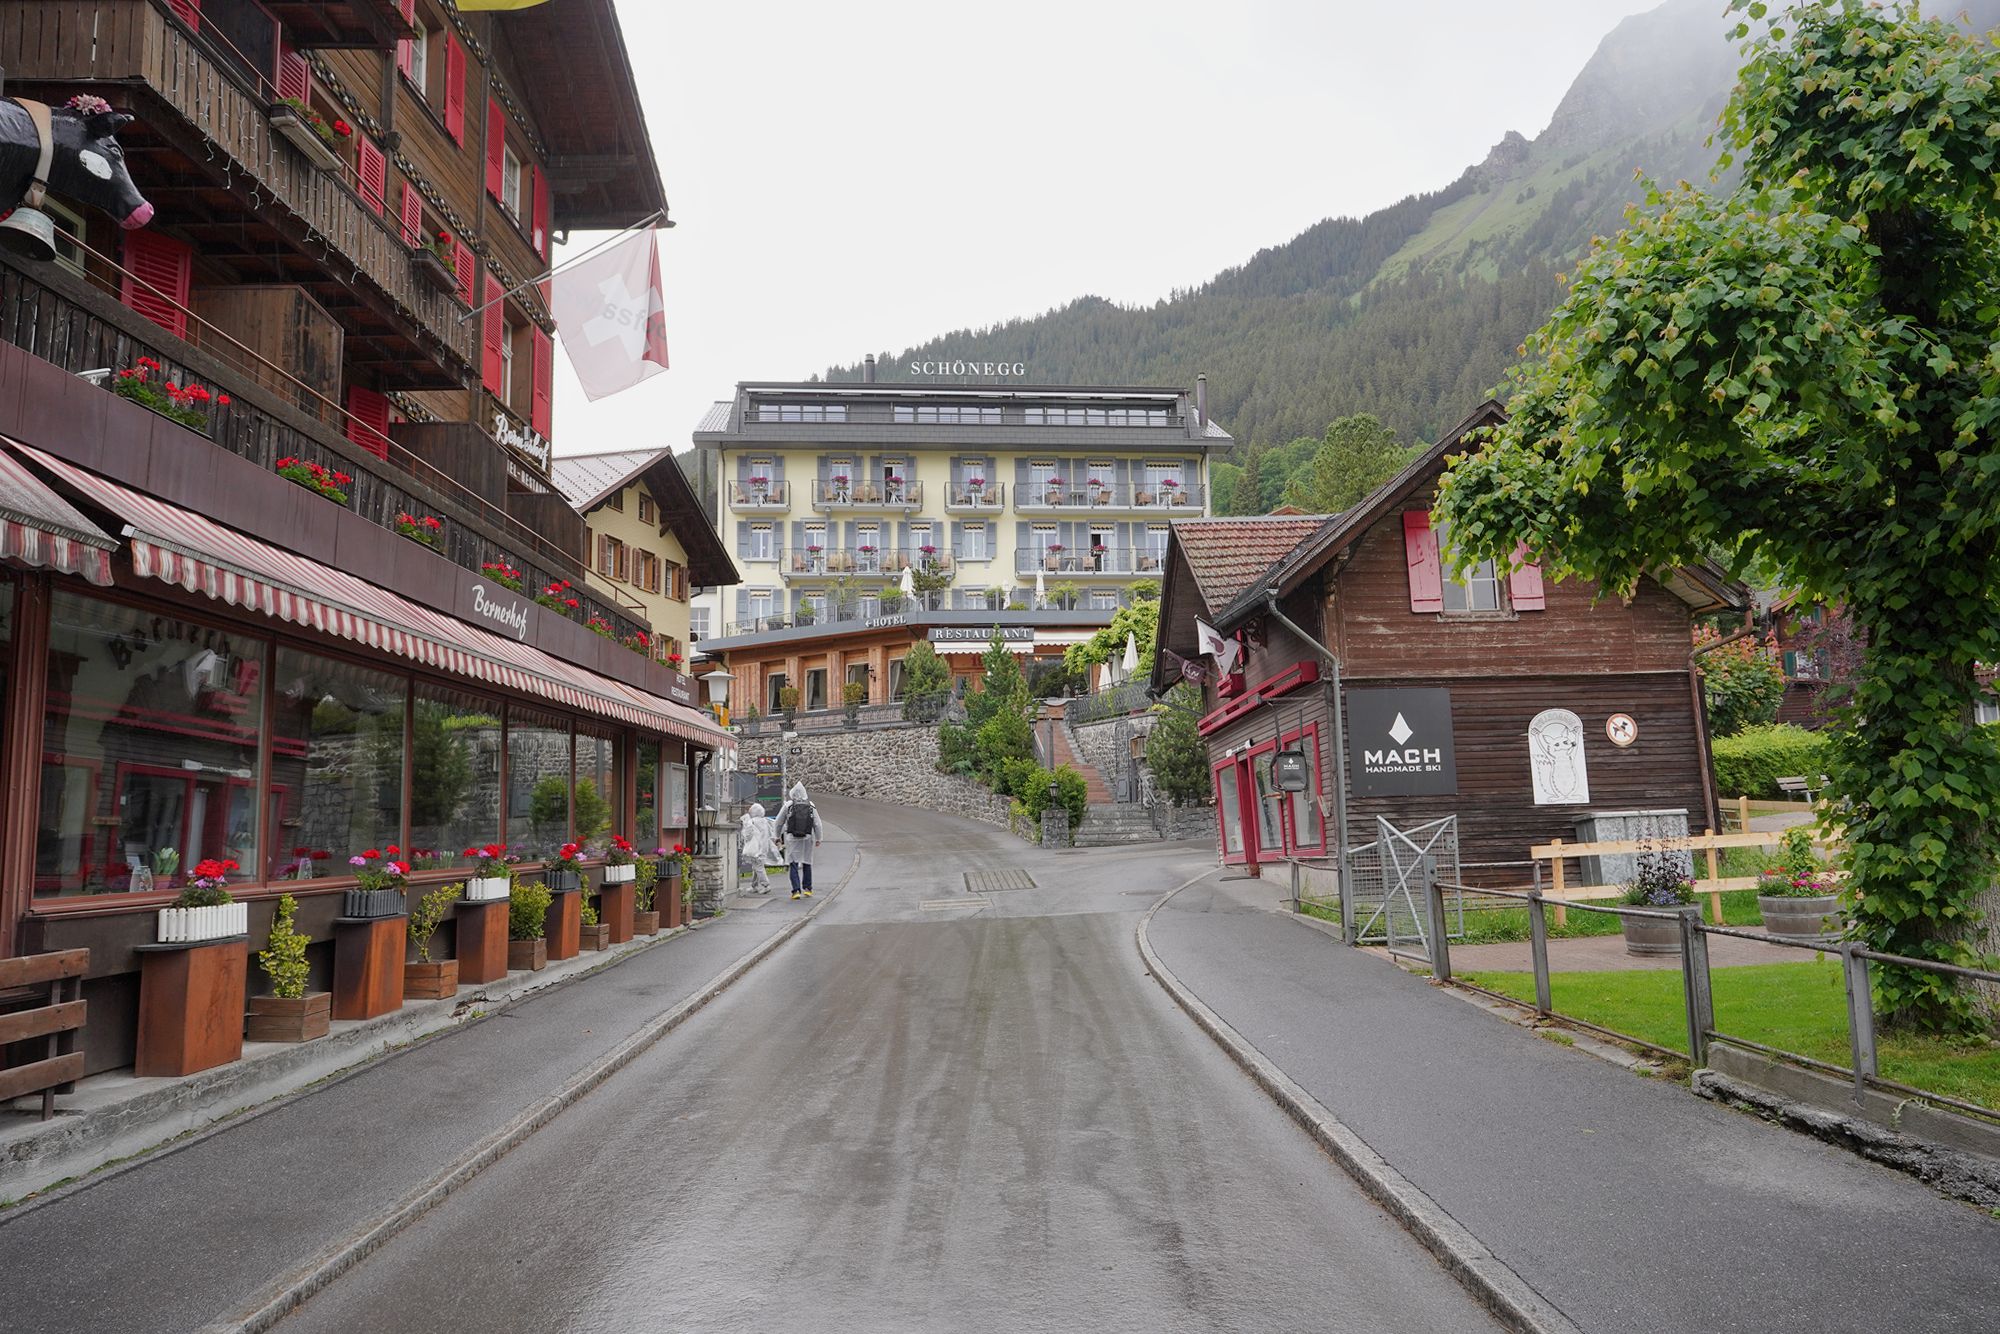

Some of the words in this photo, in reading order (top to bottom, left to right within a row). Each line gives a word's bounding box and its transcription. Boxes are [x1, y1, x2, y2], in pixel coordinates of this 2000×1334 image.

[911, 359, 1026, 376] SCHÖNEGG
[495, 413, 549, 472] Bernerhof
[472, 584, 527, 640] Bernerhof
[873, 615, 907, 628] HOTEL
[935, 627, 1030, 640] RESTAUANT
[1364, 748, 1441, 765] MACH
[1365, 765, 1422, 773] HANDMADE
[1425, 764, 1442, 772] SKI
